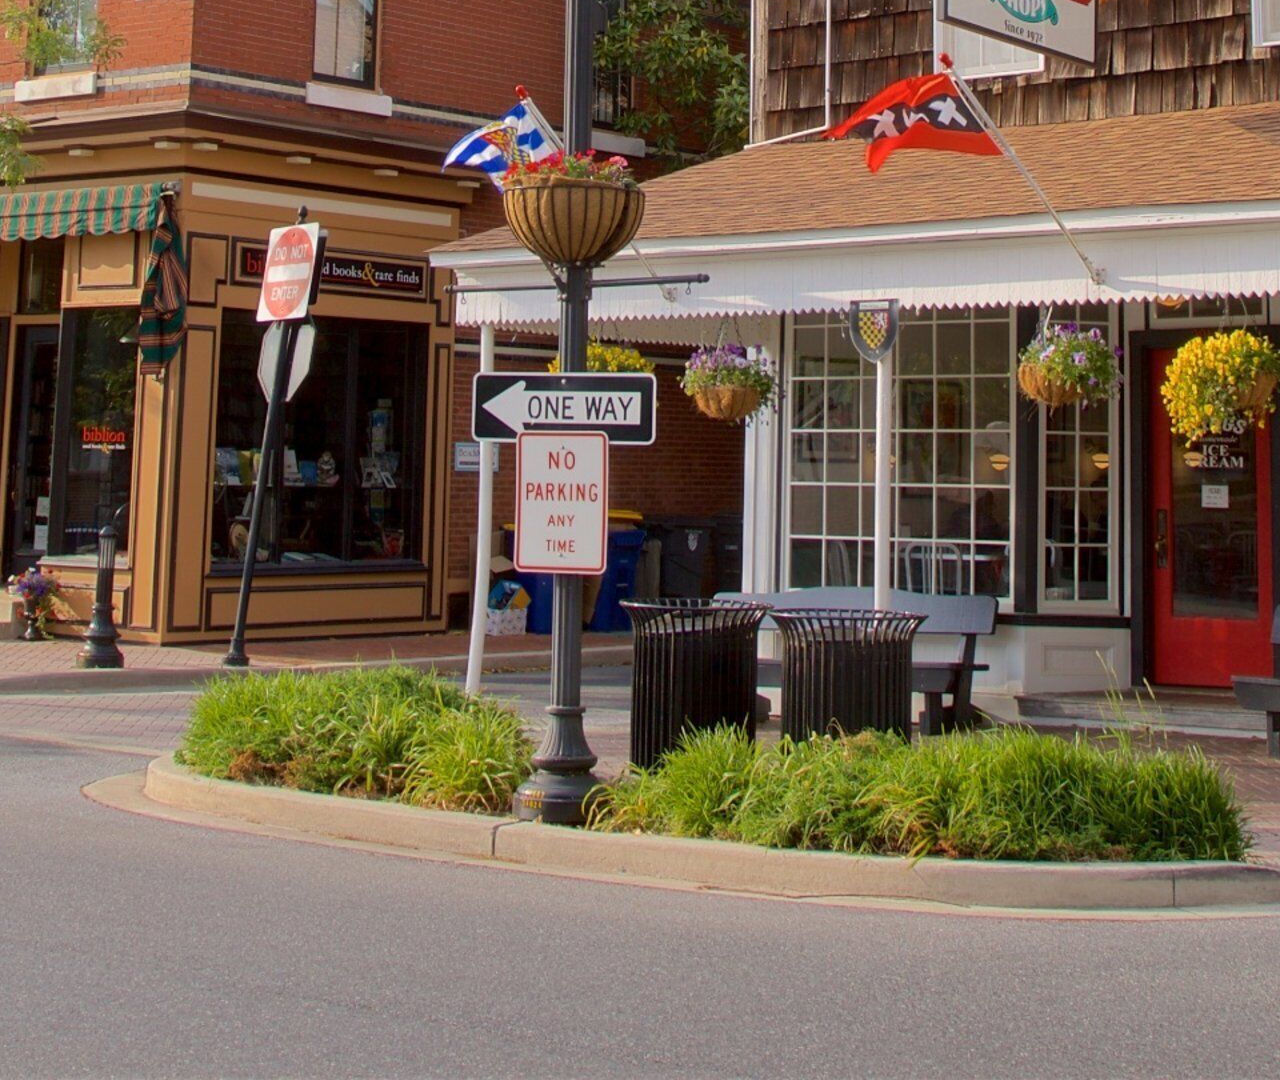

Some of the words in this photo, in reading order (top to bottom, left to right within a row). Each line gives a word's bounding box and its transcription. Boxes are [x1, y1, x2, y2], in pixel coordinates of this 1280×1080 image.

[1004, 20, 1024, 35] Since
[1027, 29, 1043, 43] 1972
[275, 246, 287, 261] DO
[290, 243, 308, 260] NOT
[334, 263, 362, 278] books
[375, 271, 393, 282] rare
[396, 270, 420, 284] finds
[271, 285, 300, 301] ENTER
[528, 395, 574, 420] ONE
[585, 396, 633, 421] WAY
[83, 426, 125, 442] biblion
[1202, 444, 1230, 457] ICE
[548, 451, 576, 470] NO
[526, 482, 598, 502] PARKING
[547, 515, 575, 527] ANY
[546, 539, 575, 553] TIME
